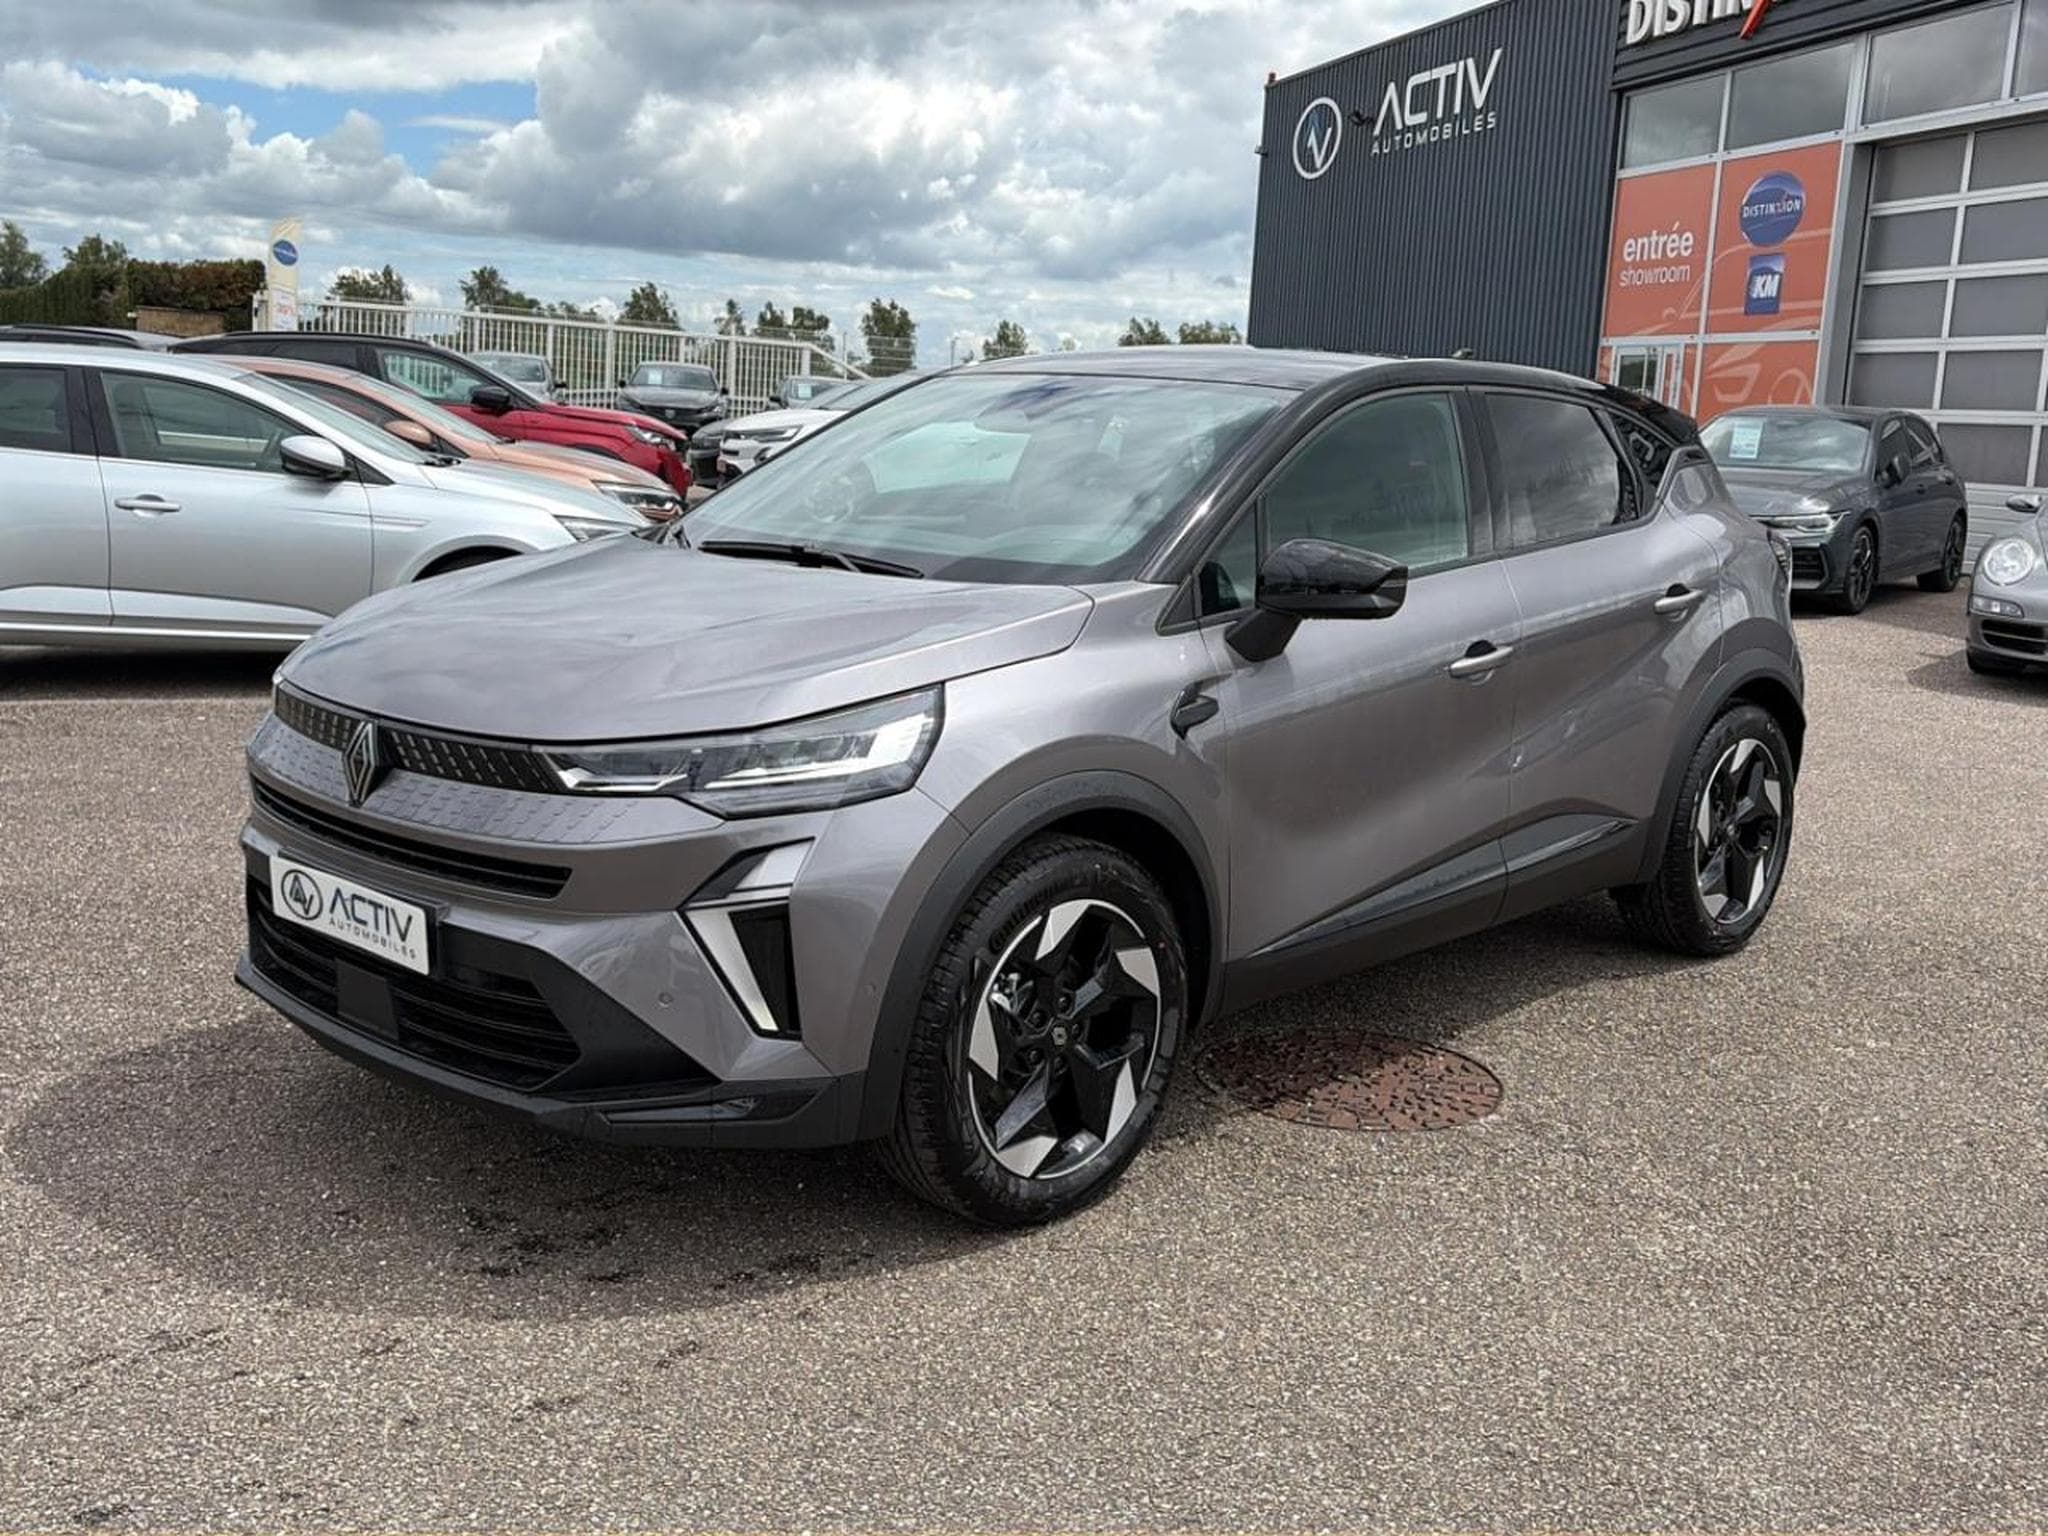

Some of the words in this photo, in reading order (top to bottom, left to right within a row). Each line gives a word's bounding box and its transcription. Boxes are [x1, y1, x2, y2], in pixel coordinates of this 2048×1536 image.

[1372, 47, 1503, 137] ACTIV
[1370, 111, 1498, 156] AUTOMOBILES
[1623, 220, 1694, 263] entrée
[1619, 264, 1691, 287] showroom
[329, 887, 413, 942] ACTIV
[329, 918, 417, 960] AUTOMOBILES
